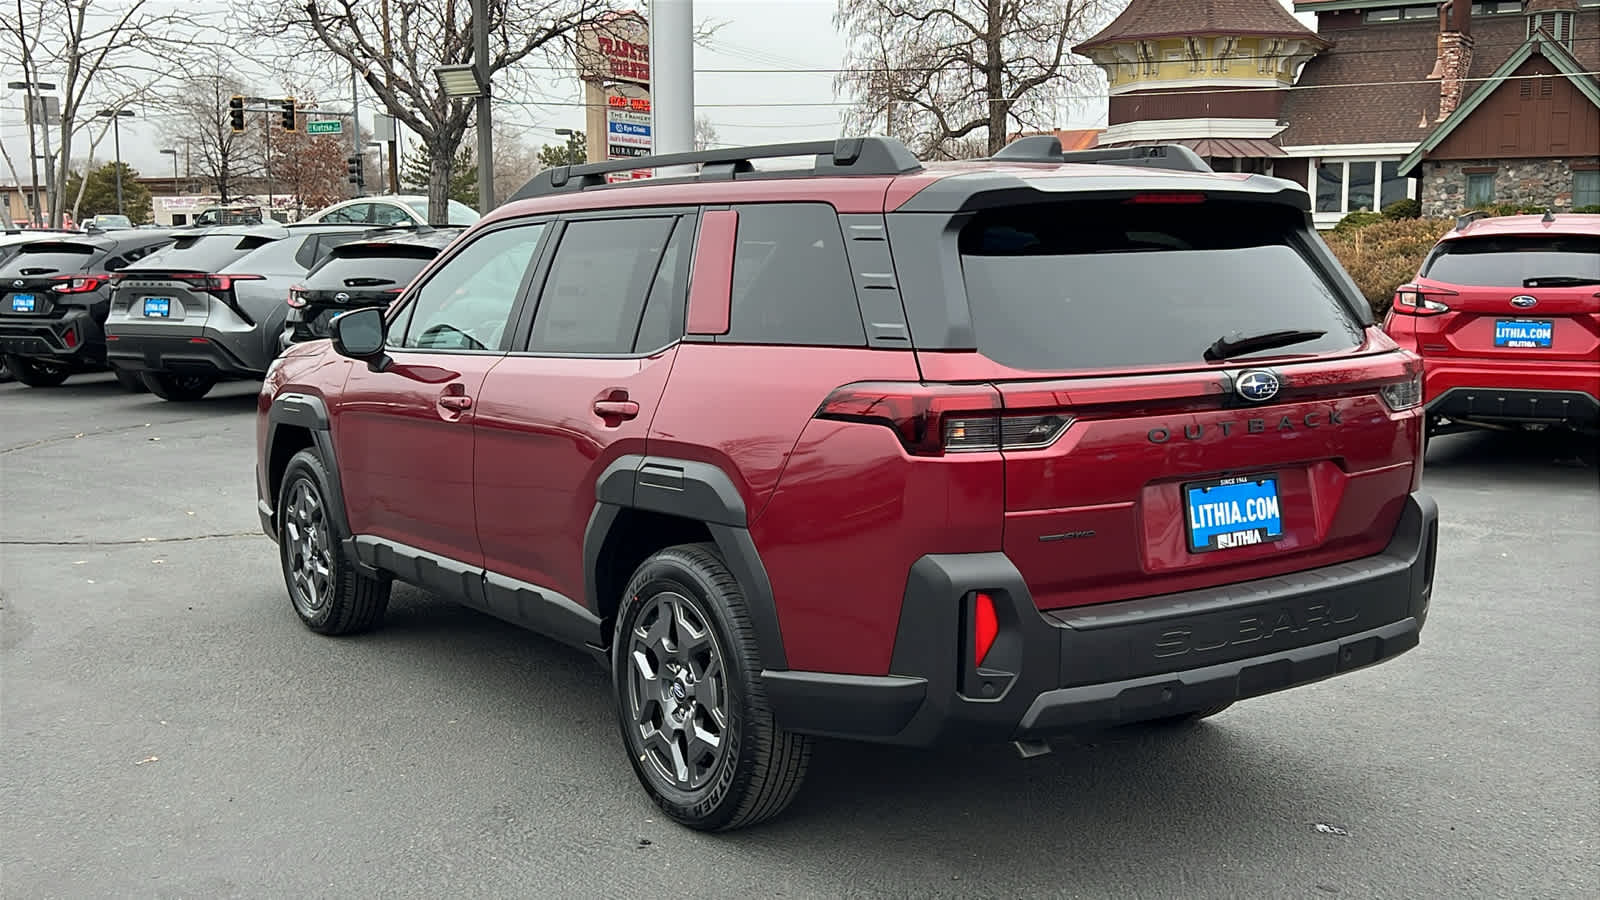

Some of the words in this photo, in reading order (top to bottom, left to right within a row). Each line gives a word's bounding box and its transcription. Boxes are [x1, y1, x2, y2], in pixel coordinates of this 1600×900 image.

[611, 145, 631, 155] AURA
[1496, 327, 1552, 339] LITHIA.COM
[1147, 410, 1343, 444] OUTBACK
[1190, 495, 1280, 529] LITHIA.COM
[1228, 529, 1262, 547] LITHIA
[1154, 603, 1360, 659] SUBARU
